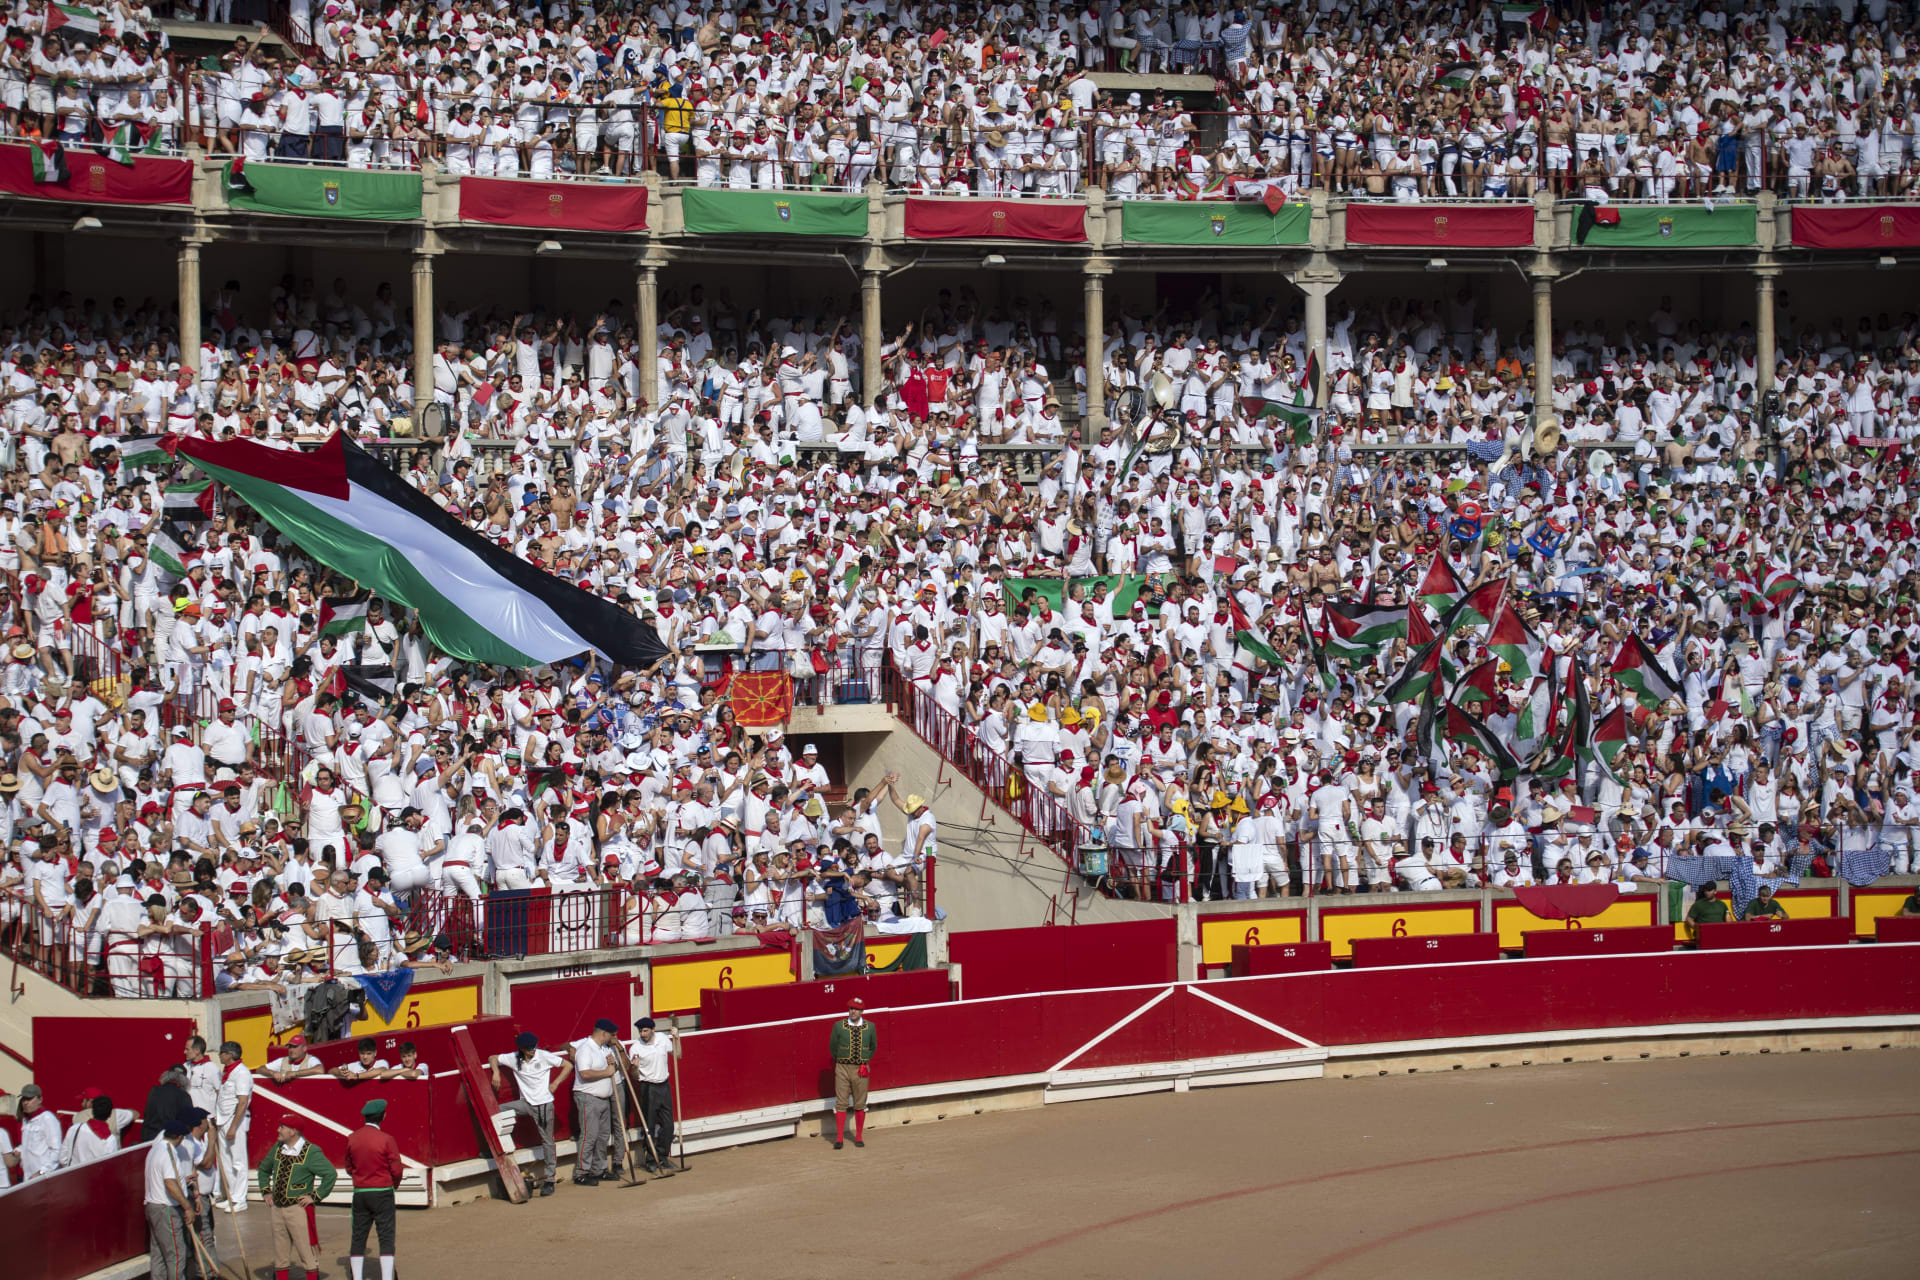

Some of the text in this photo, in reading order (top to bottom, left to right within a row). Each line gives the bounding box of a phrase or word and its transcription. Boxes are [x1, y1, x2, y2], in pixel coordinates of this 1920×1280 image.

[1245, 926, 1260, 946] 6
[1392, 918, 1407, 938] 6
[557, 964, 593, 979] TORIL
[719, 966, 733, 990] 6
[407, 1001, 420, 1028] 5
